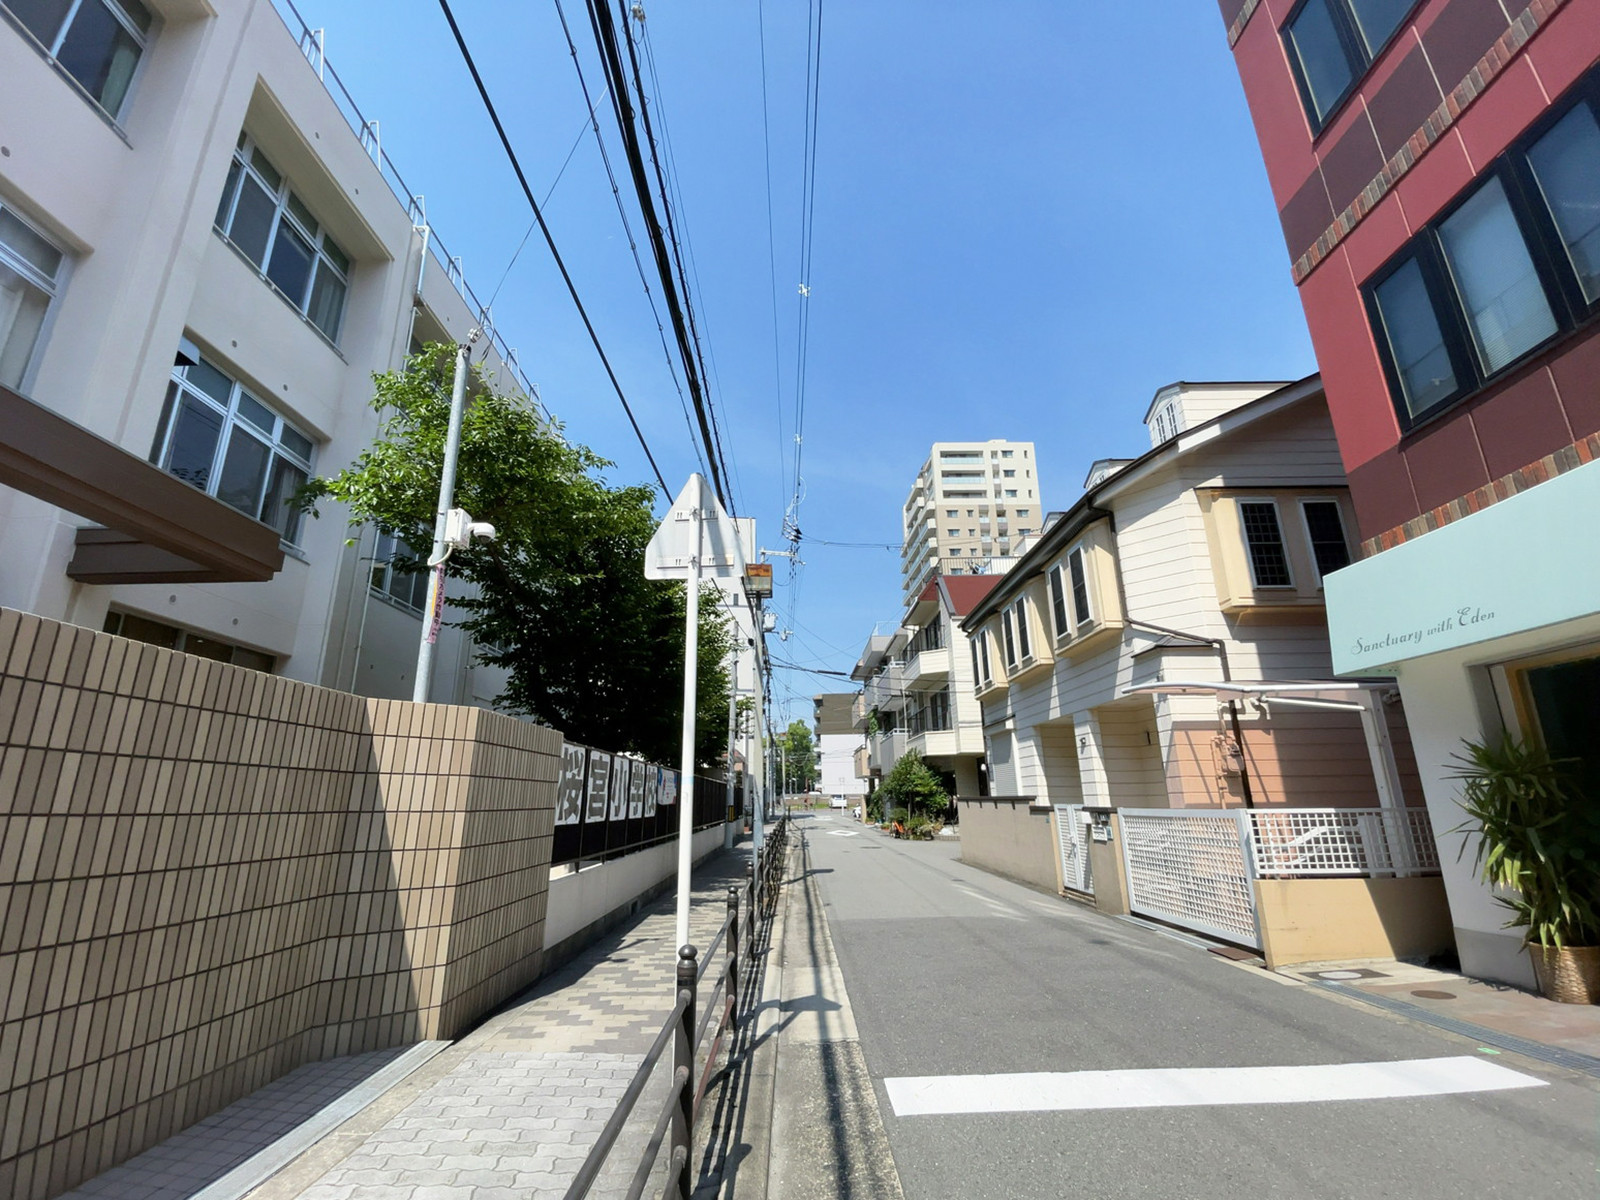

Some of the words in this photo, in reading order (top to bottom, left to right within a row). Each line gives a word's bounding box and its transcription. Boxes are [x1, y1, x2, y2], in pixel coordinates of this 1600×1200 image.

[1352, 630, 1423, 655] Sanctuary
[1427, 617, 1453, 636] with
[1457, 606, 1495, 626] Eden
